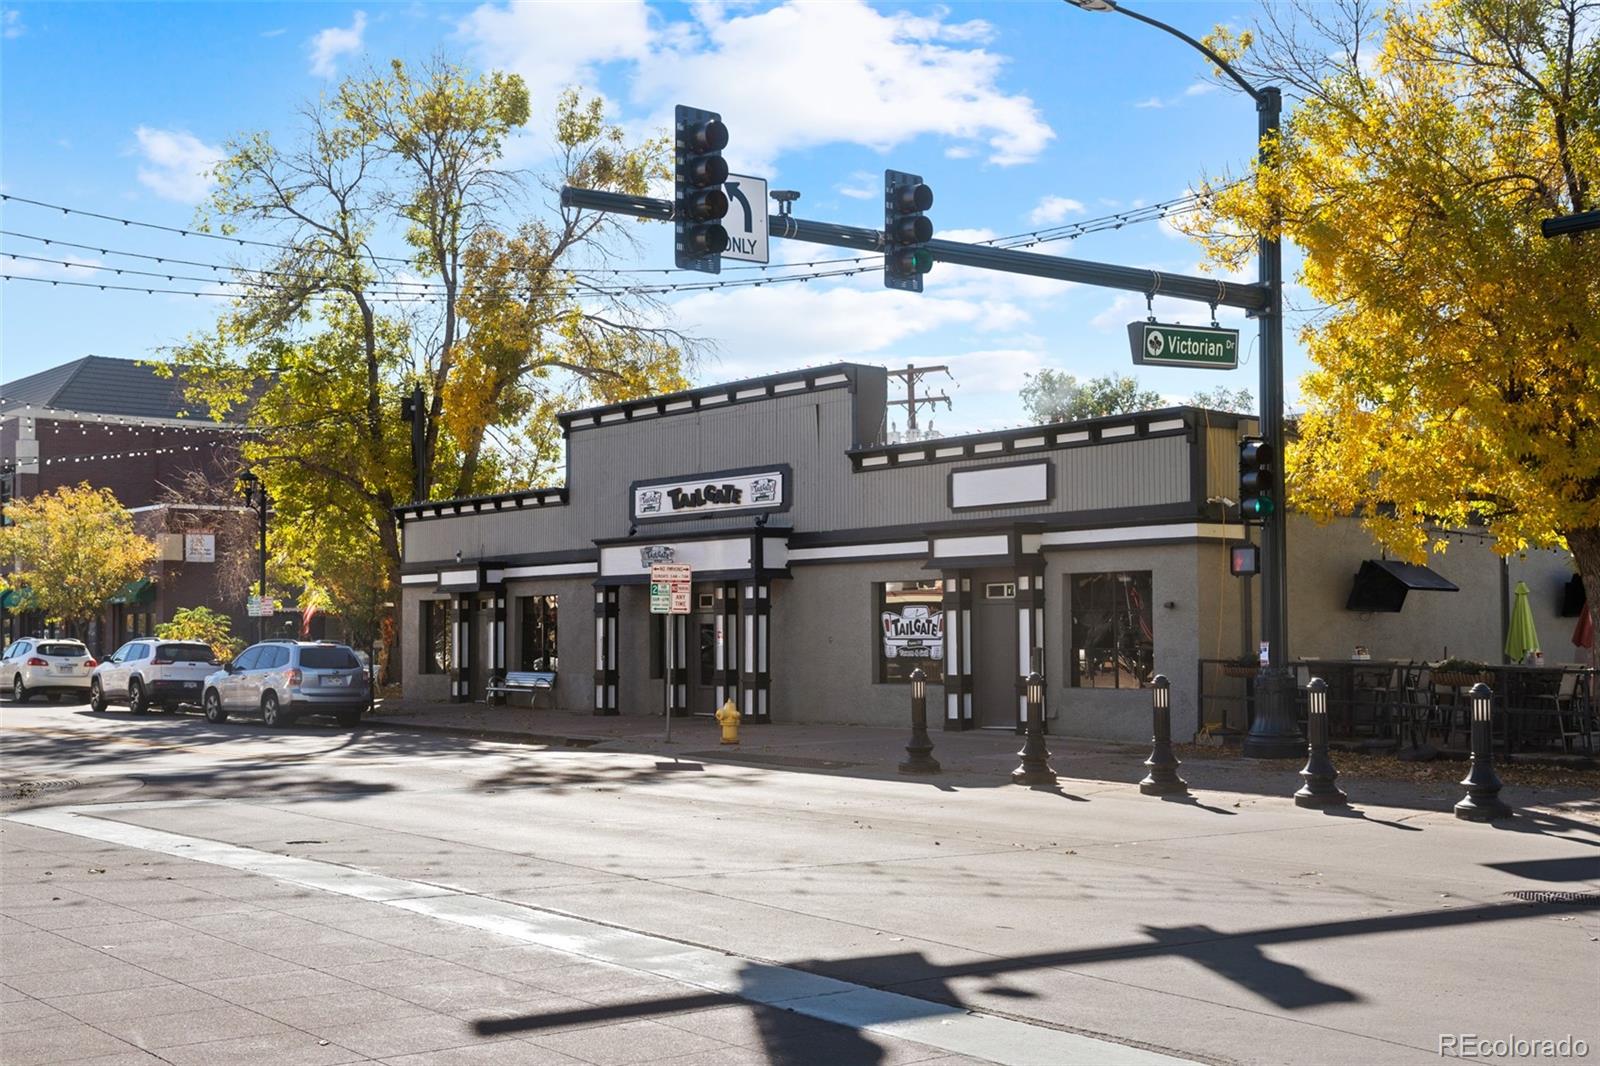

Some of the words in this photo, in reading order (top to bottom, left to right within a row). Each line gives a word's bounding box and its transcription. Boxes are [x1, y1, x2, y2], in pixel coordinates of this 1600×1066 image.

[1168, 335, 1224, 357] Victorian
[1226, 339, 1235, 349] Dr
[652, 584, 658, 595] 2
[891, 618, 938, 637] TAILGATE
